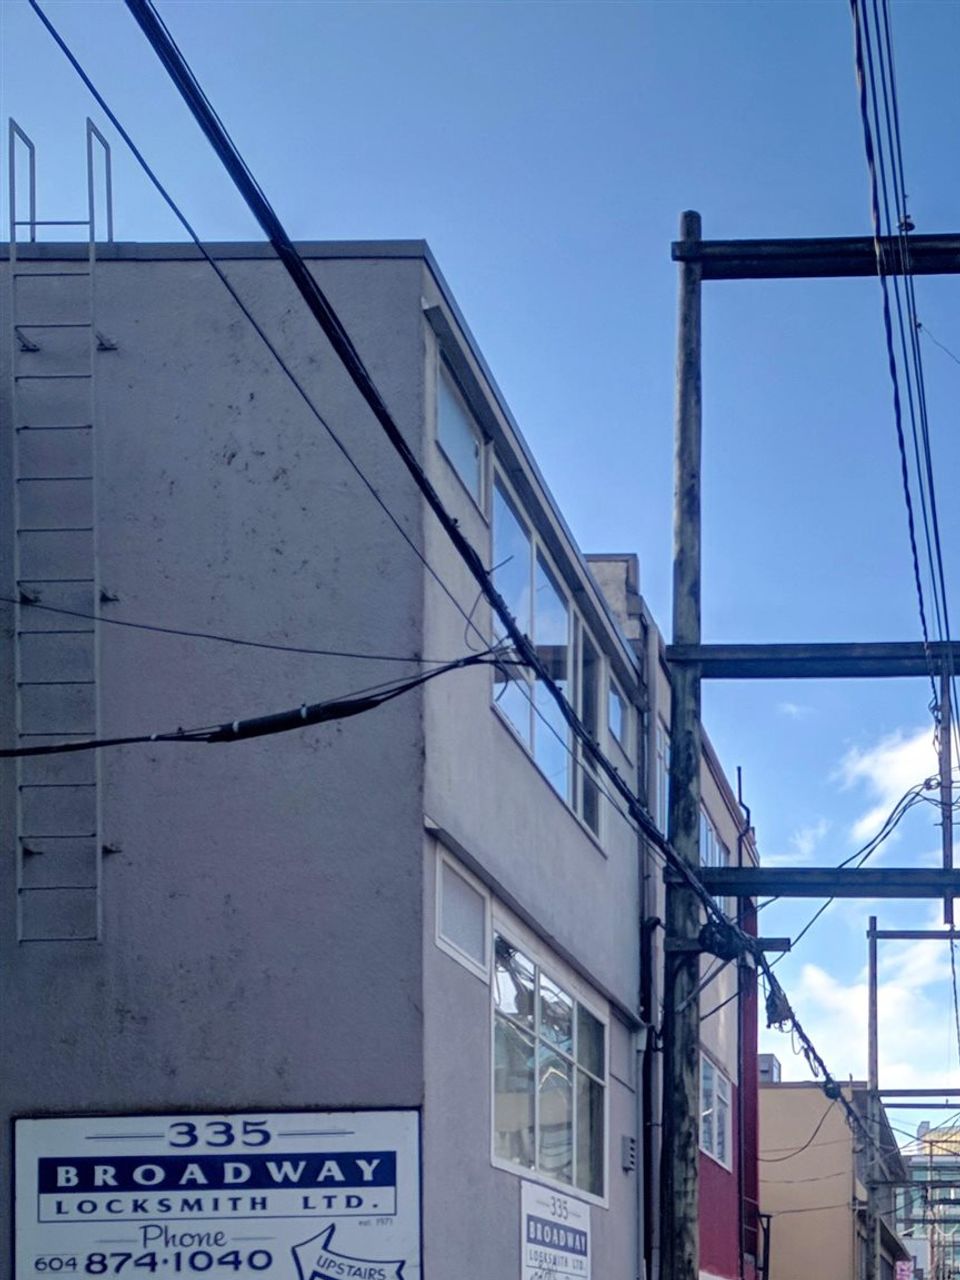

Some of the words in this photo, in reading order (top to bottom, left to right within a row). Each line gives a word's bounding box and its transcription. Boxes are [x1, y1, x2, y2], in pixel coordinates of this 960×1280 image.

[168, 1120, 273, 1148] 335
[56, 1158, 382, 1188] BROADWAY
[55, 1196, 269, 1215] LOCKSMITH
[302, 1195, 380, 1211] LTD.
[551, 1197, 569, 1220] 335
[139, 1224, 229, 1250] Phone
[529, 1220, 587, 1252] BROADWAY
[35, 1256, 77, 1273] 604
[529, 1250, 568, 1267] LOCKSMITH
